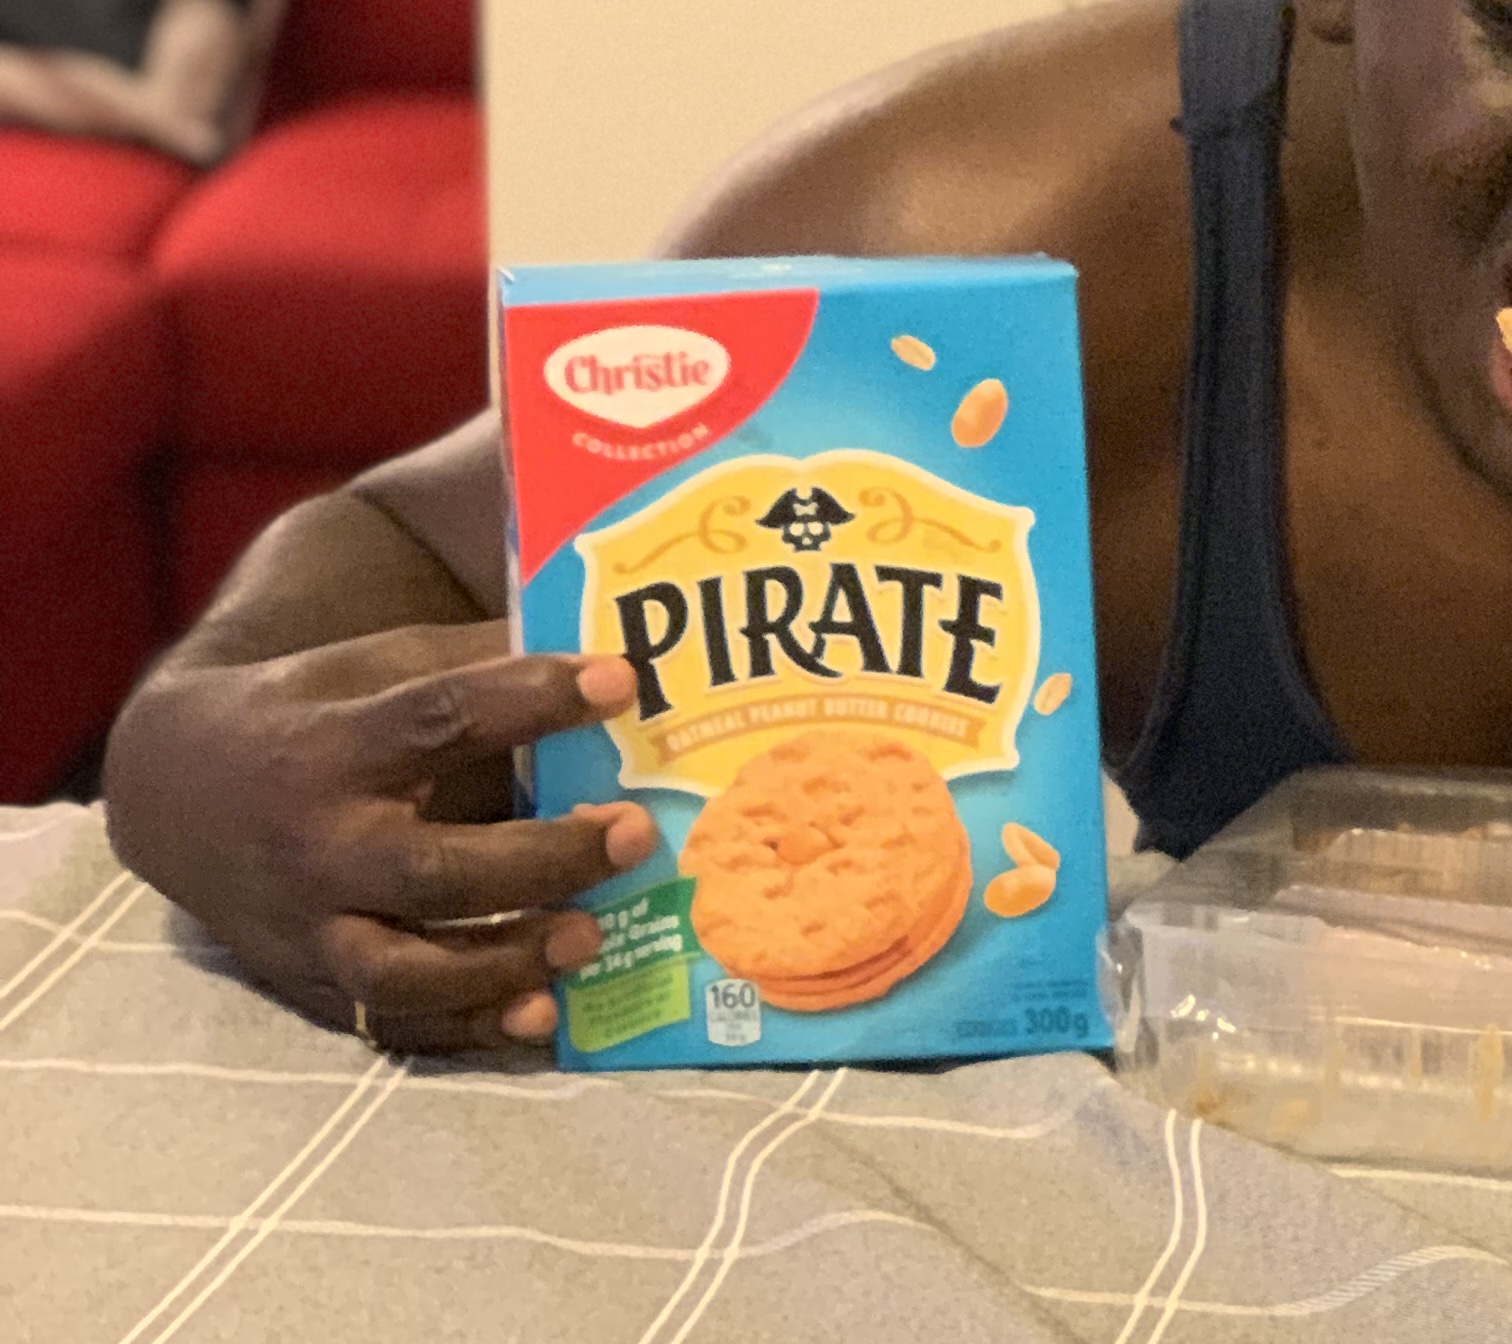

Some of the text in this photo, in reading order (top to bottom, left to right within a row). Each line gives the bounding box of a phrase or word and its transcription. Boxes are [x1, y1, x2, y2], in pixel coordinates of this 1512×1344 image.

[563, 351, 712, 396] Christie
[572, 421, 709, 460] COLLECTION
[613, 562, 1003, 722] PIRATE
[665, 697, 971, 752] OATMEAL PEANUT BUTTER COOKIES
[711, 983, 756, 1009] 160
